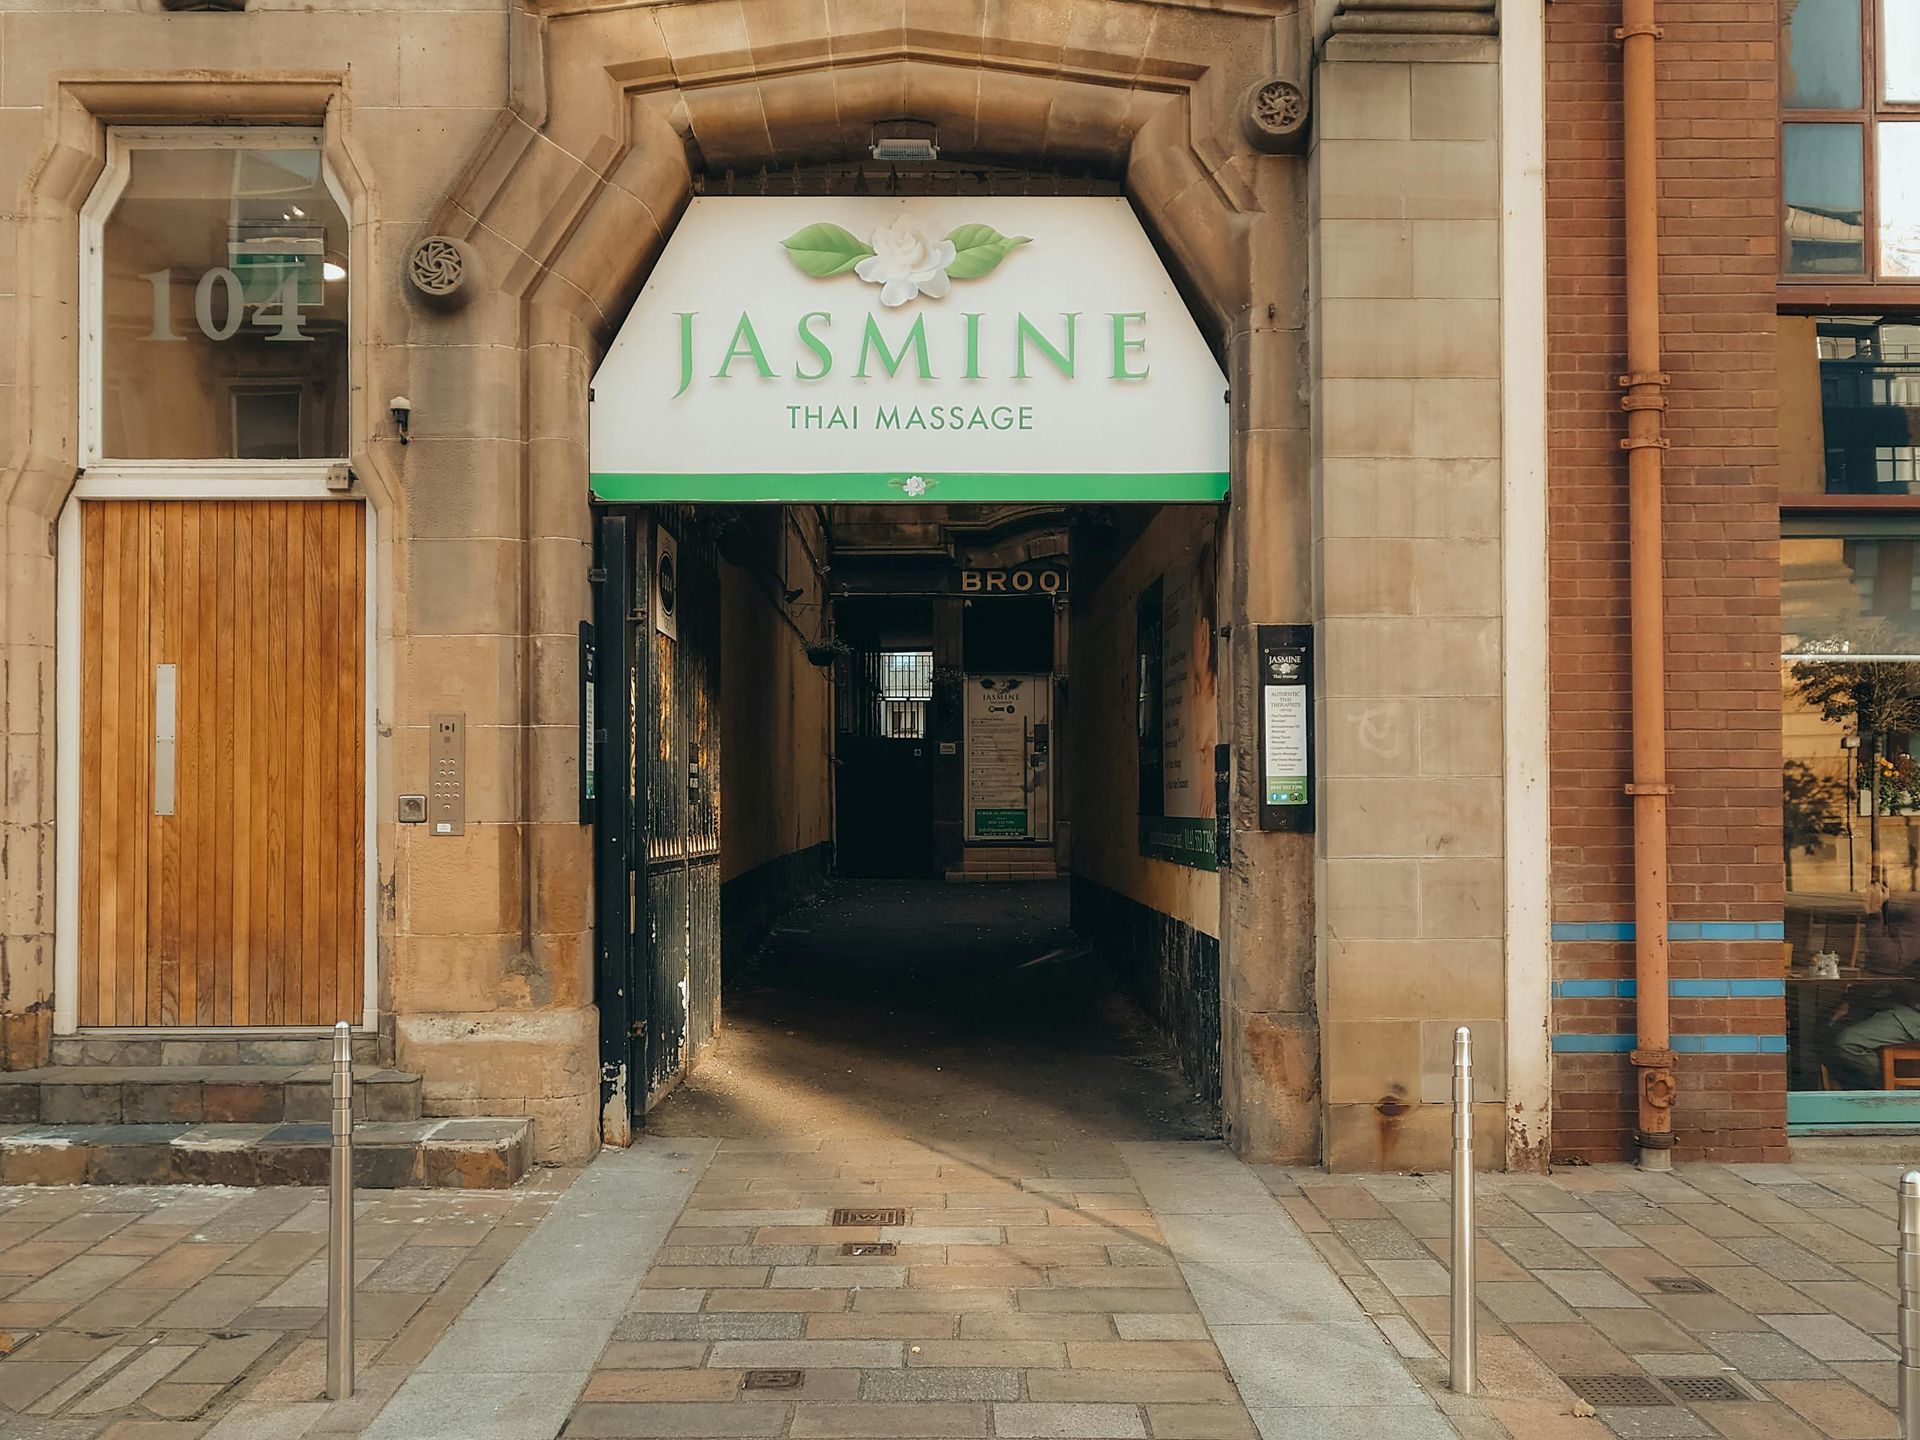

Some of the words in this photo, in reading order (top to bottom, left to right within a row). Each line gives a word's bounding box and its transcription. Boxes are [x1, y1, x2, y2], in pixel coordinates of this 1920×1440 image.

[136, 266, 315, 343] 104
[671, 310, 1151, 400] JASMINE
[786, 404, 859, 430] THAI
[874, 404, 1034, 431] MASSAGE
[1268, 655, 1302, 665] JASMINE
